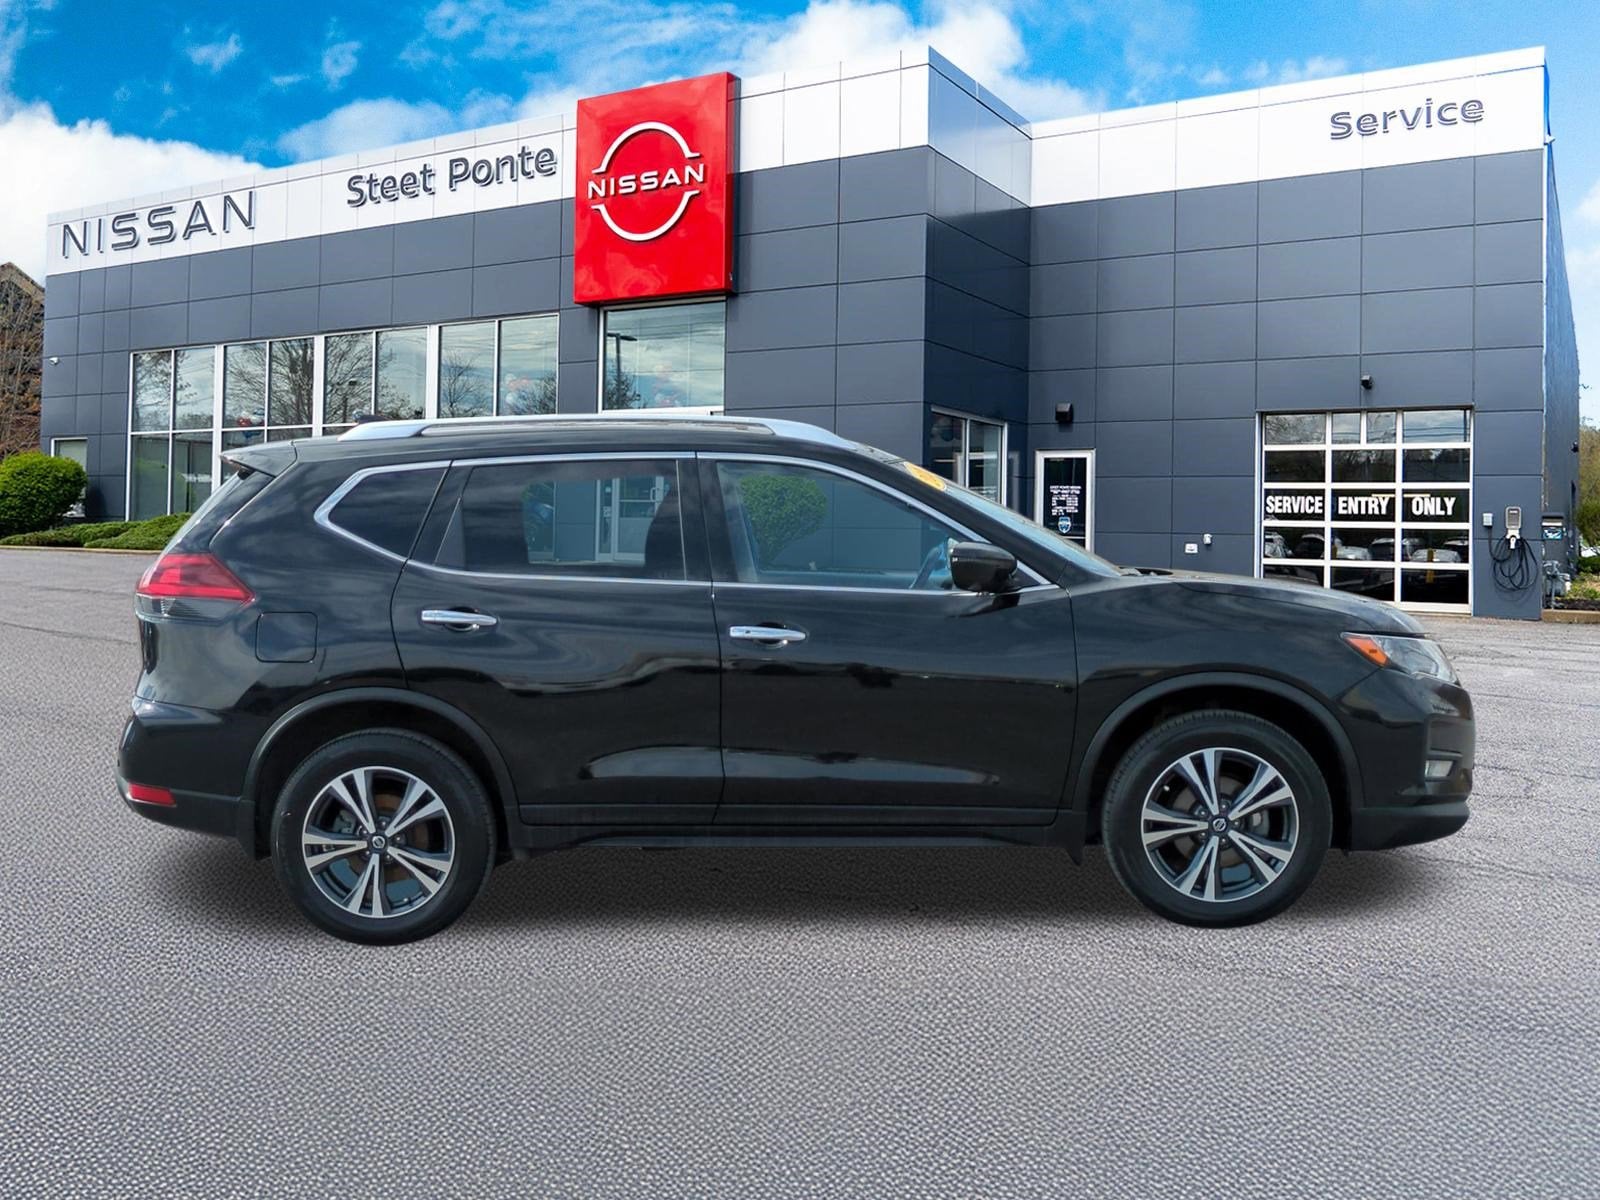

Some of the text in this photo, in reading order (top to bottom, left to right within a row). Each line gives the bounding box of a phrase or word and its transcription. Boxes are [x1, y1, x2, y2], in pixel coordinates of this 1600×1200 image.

[1330, 98, 1484, 140] Service
[346, 145, 558, 207] Steet Ponte
[587, 163, 705, 200] NISSAN
[62, 190, 256, 259] NISSAN
[1265, 495, 1457, 516] SERVICE ENTRY ONLY
